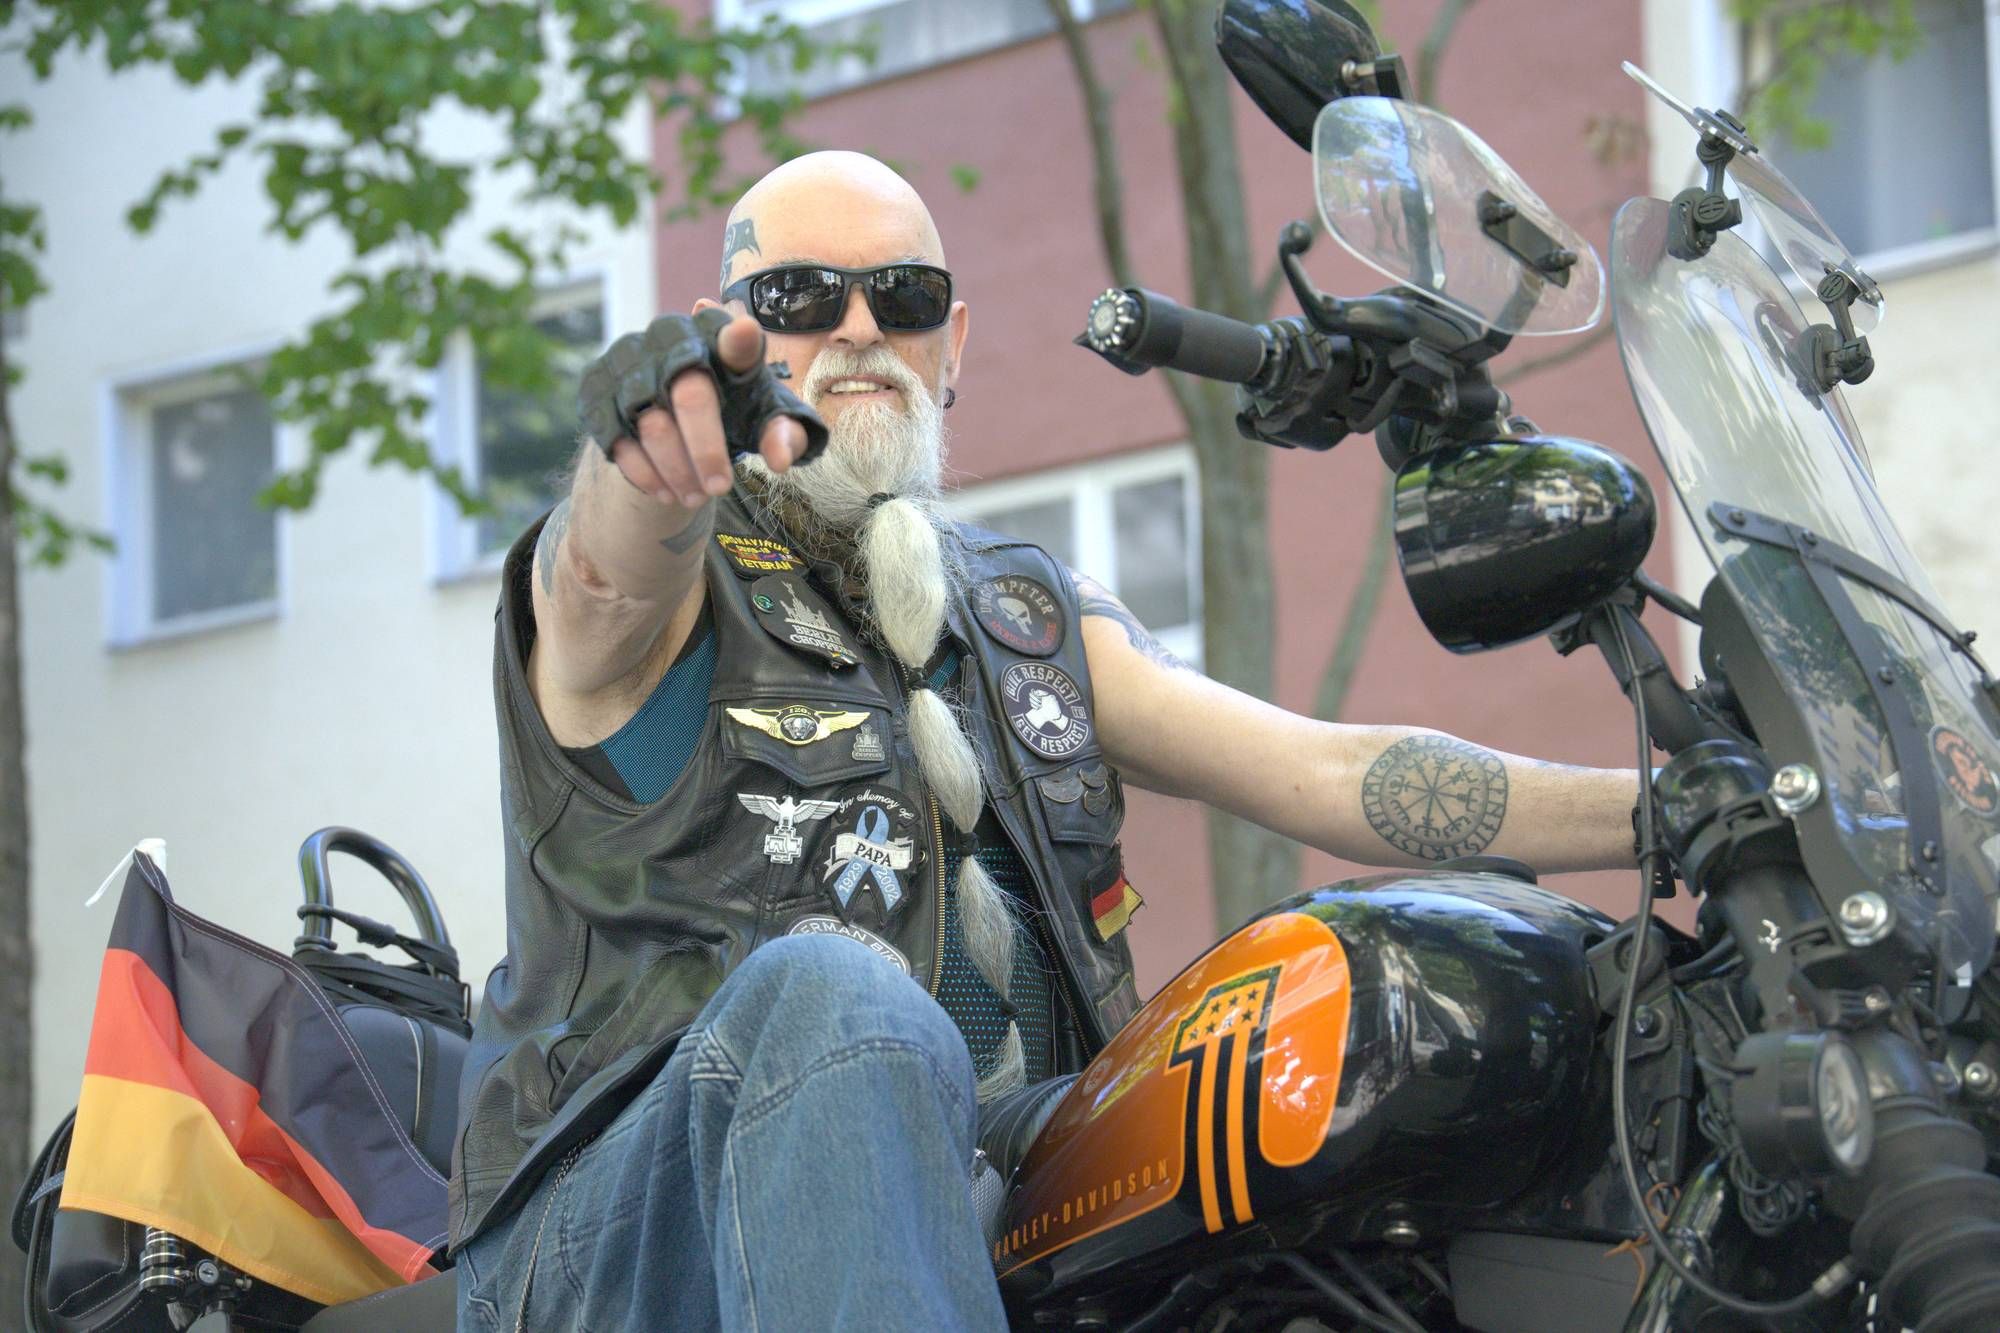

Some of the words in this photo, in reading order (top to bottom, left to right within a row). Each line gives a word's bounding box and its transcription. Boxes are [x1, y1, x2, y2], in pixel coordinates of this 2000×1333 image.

[736, 556, 793, 571] VETERAN
[792, 624, 844, 647] BERLIN
[1006, 670, 1022, 697] GIVE
[1021, 666, 1077, 702] RESPECT
[1016, 719, 1037, 742] GET
[1041, 723, 1086, 753] RESPECT
[854, 842, 892, 867] PAPA
[839, 862, 863, 893] 1929
[876, 866, 899, 902] 2002
[800, 922, 866, 941] ERMAN
[993, 1159, 1169, 1263] HARLEY-DAVIDSON
